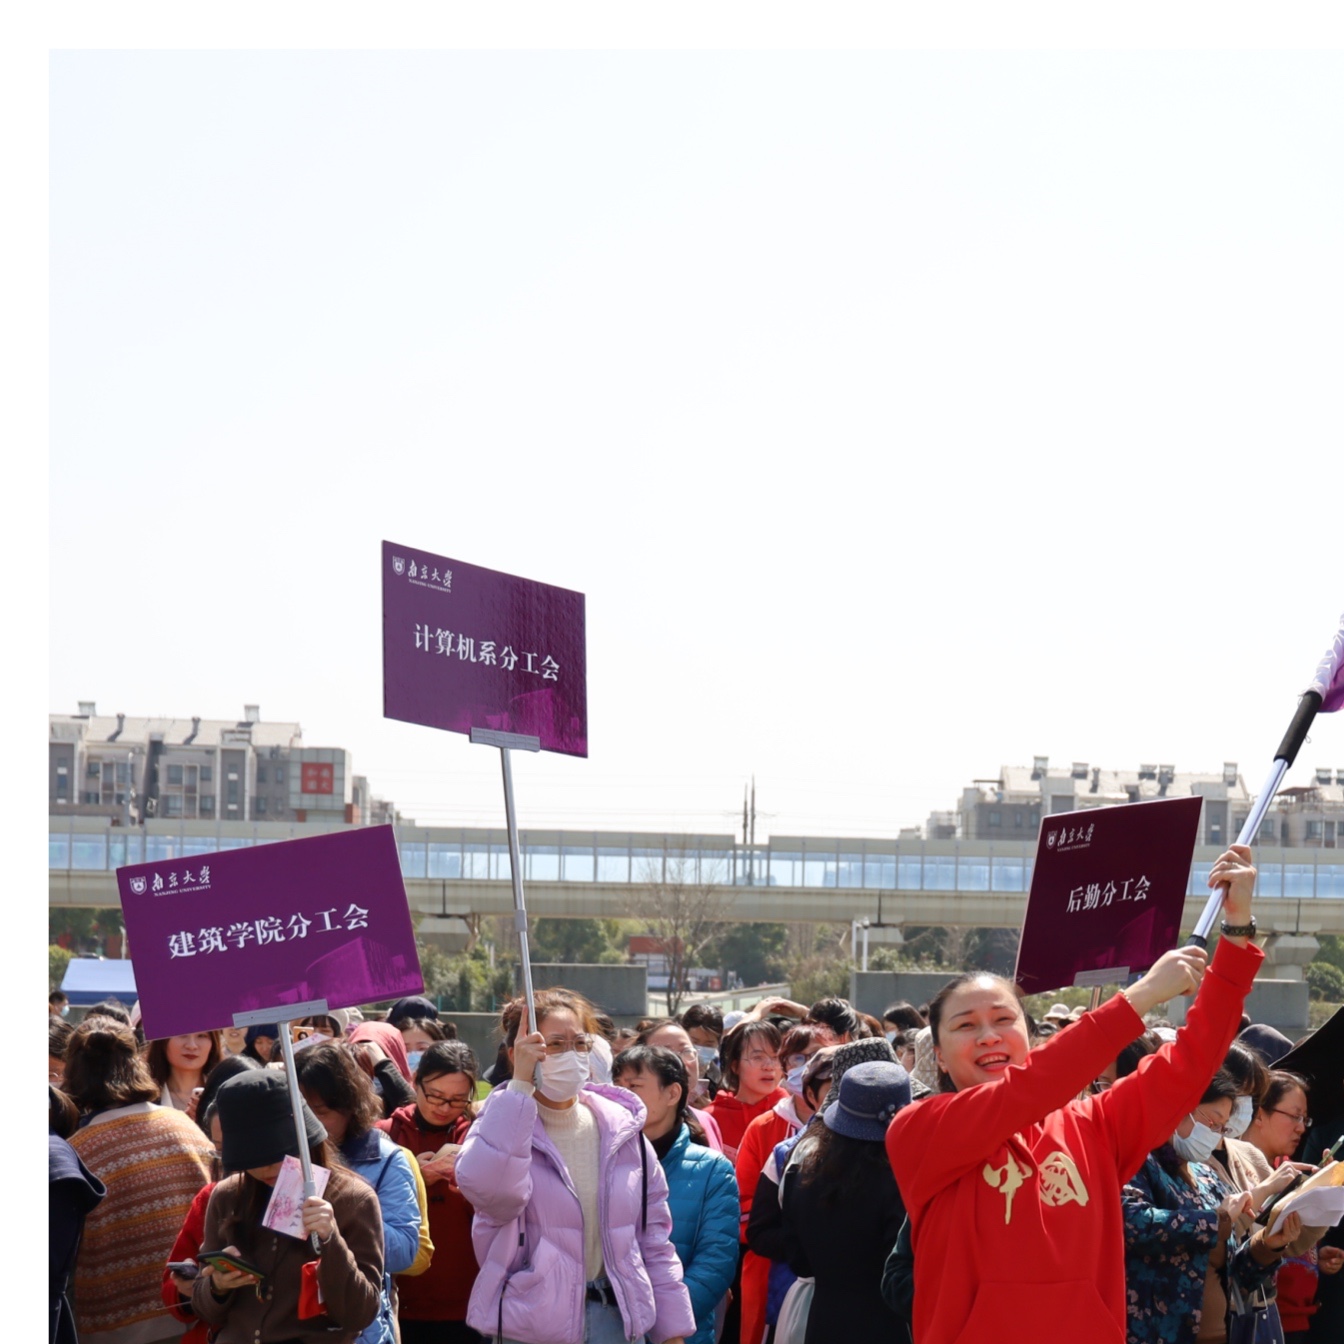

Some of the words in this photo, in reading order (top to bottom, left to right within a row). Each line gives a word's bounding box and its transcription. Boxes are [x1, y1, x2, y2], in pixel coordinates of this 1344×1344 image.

[413, 623, 560, 682] 计算机系分工会
[1065, 874, 1151, 913] 后勤分工会
[167, 903, 370, 960] 建筑学院分工会
